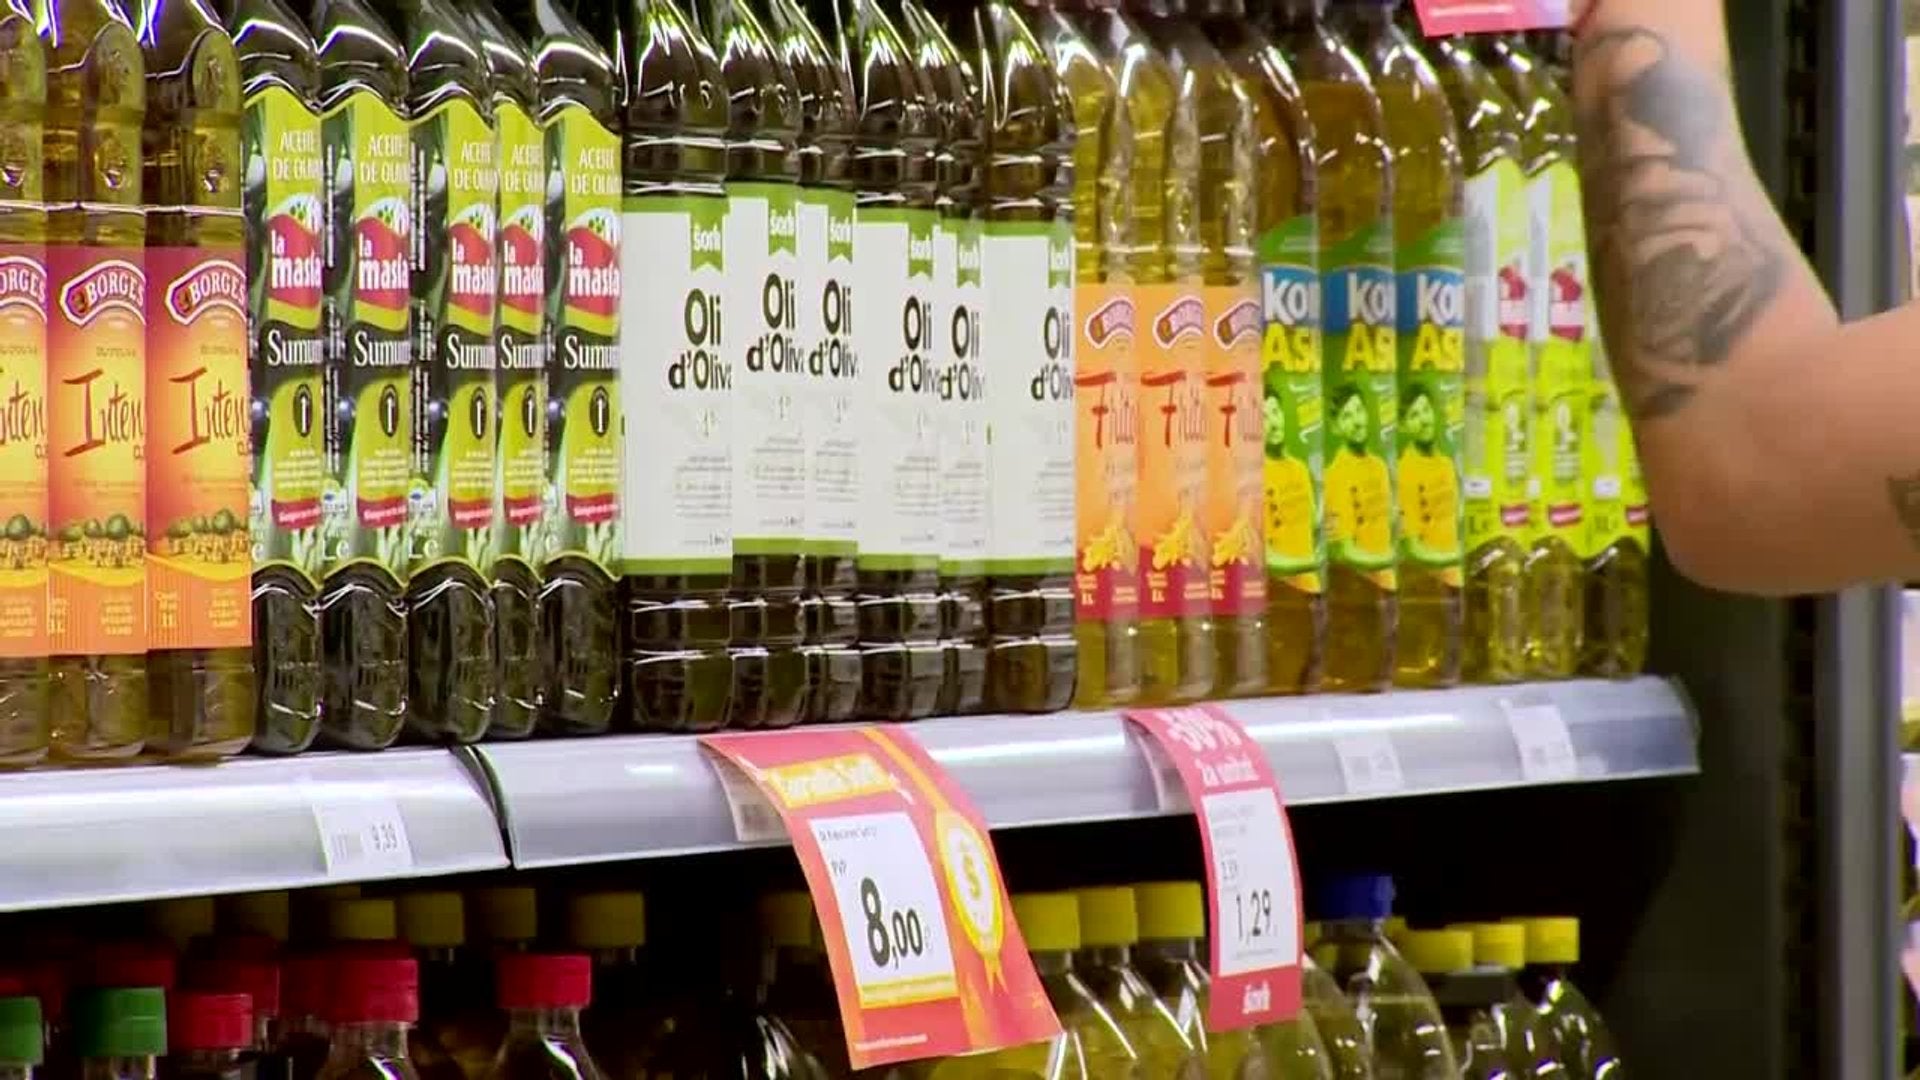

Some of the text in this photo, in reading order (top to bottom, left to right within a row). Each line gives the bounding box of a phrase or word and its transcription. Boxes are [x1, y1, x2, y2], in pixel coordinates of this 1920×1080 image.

[273, 157, 288, 180] DE
[360, 161, 377, 183] DE
[454, 168, 470, 191] DE
[505, 170, 521, 192] DE
[572, 174, 587, 194] DE
[271, 229, 285, 255] la
[358, 232, 372, 257] la
[452, 238, 465, 263] la
[503, 240, 516, 264] la
[569, 241, 584, 265] la
[85, 267, 145, 306] BORGES
[189, 269, 246, 306] BORGES
[763, 273, 795, 329] Oli
[823, 279, 852, 336] Oli
[684, 287, 721, 346] Oli
[904, 296, 932, 351] Oli
[952, 304, 980, 358] Oli
[1044, 306, 1070, 360] Oli
[1236, 889, 1272, 945] 1,29
